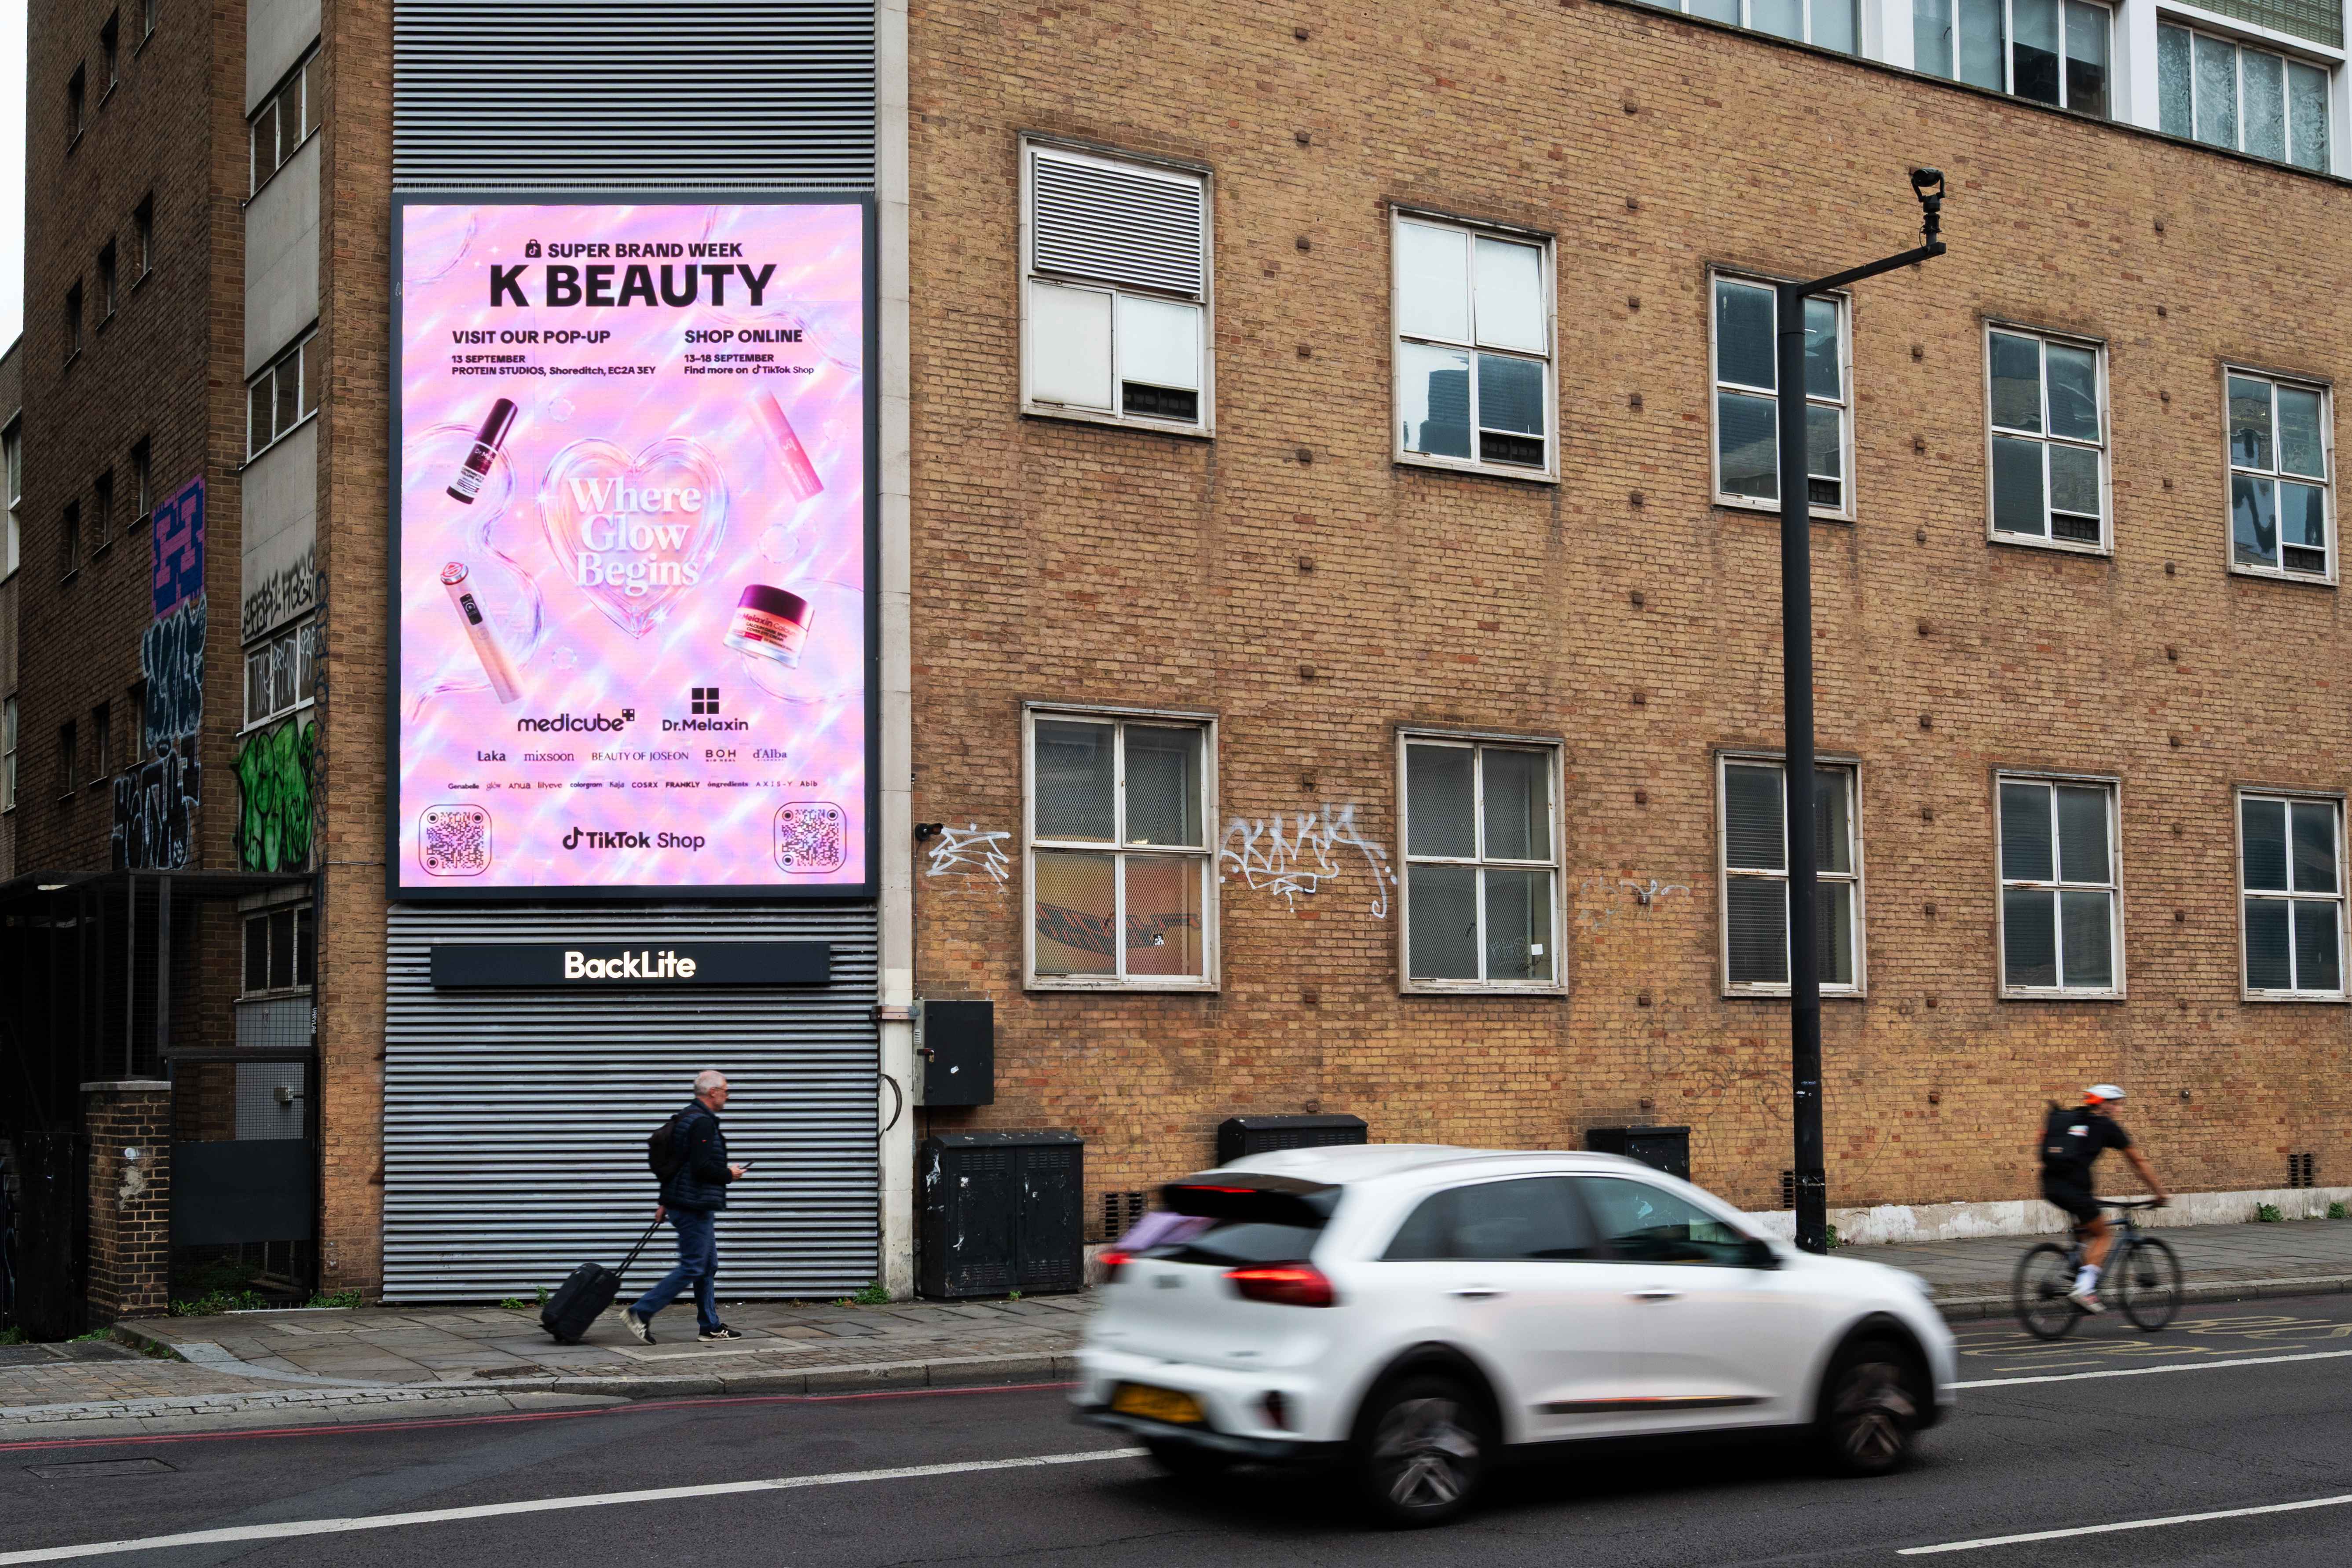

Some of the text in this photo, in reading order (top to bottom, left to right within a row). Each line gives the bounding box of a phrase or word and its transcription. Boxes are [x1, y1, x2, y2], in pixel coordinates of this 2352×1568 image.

[548, 243, 743, 258] SUPER BRAND WEEK
[490, 263, 777, 308] K BEAUTY
[452, 330, 611, 344] VISIT OUR POP-UP
[685, 329, 803, 344] SHOP ONLINE
[452, 355, 526, 364] 13 SEPTEMBER
[714, 354, 774, 362] SEPTEMBER
[452, 366, 656, 376] PROTEIN STUDIOS, Shoreditch, EC2A 3EY
[684, 366, 706, 374] Find
[762, 366, 791, 374] TikTok
[793, 366, 814, 375] Shop
[568, 475, 701, 513] Where
[581, 512, 690, 552] Glow
[576, 551, 700, 597] Begins
[517, 713, 624, 732] medicube
[478, 750, 506, 761] Laka
[524, 750, 574, 762] mixsoon
[592, 751, 689, 761] BEAUTY OF JOSEON
[586, 831, 705, 852] TikTok Shop
[565, 951, 696, 979] BackLite
